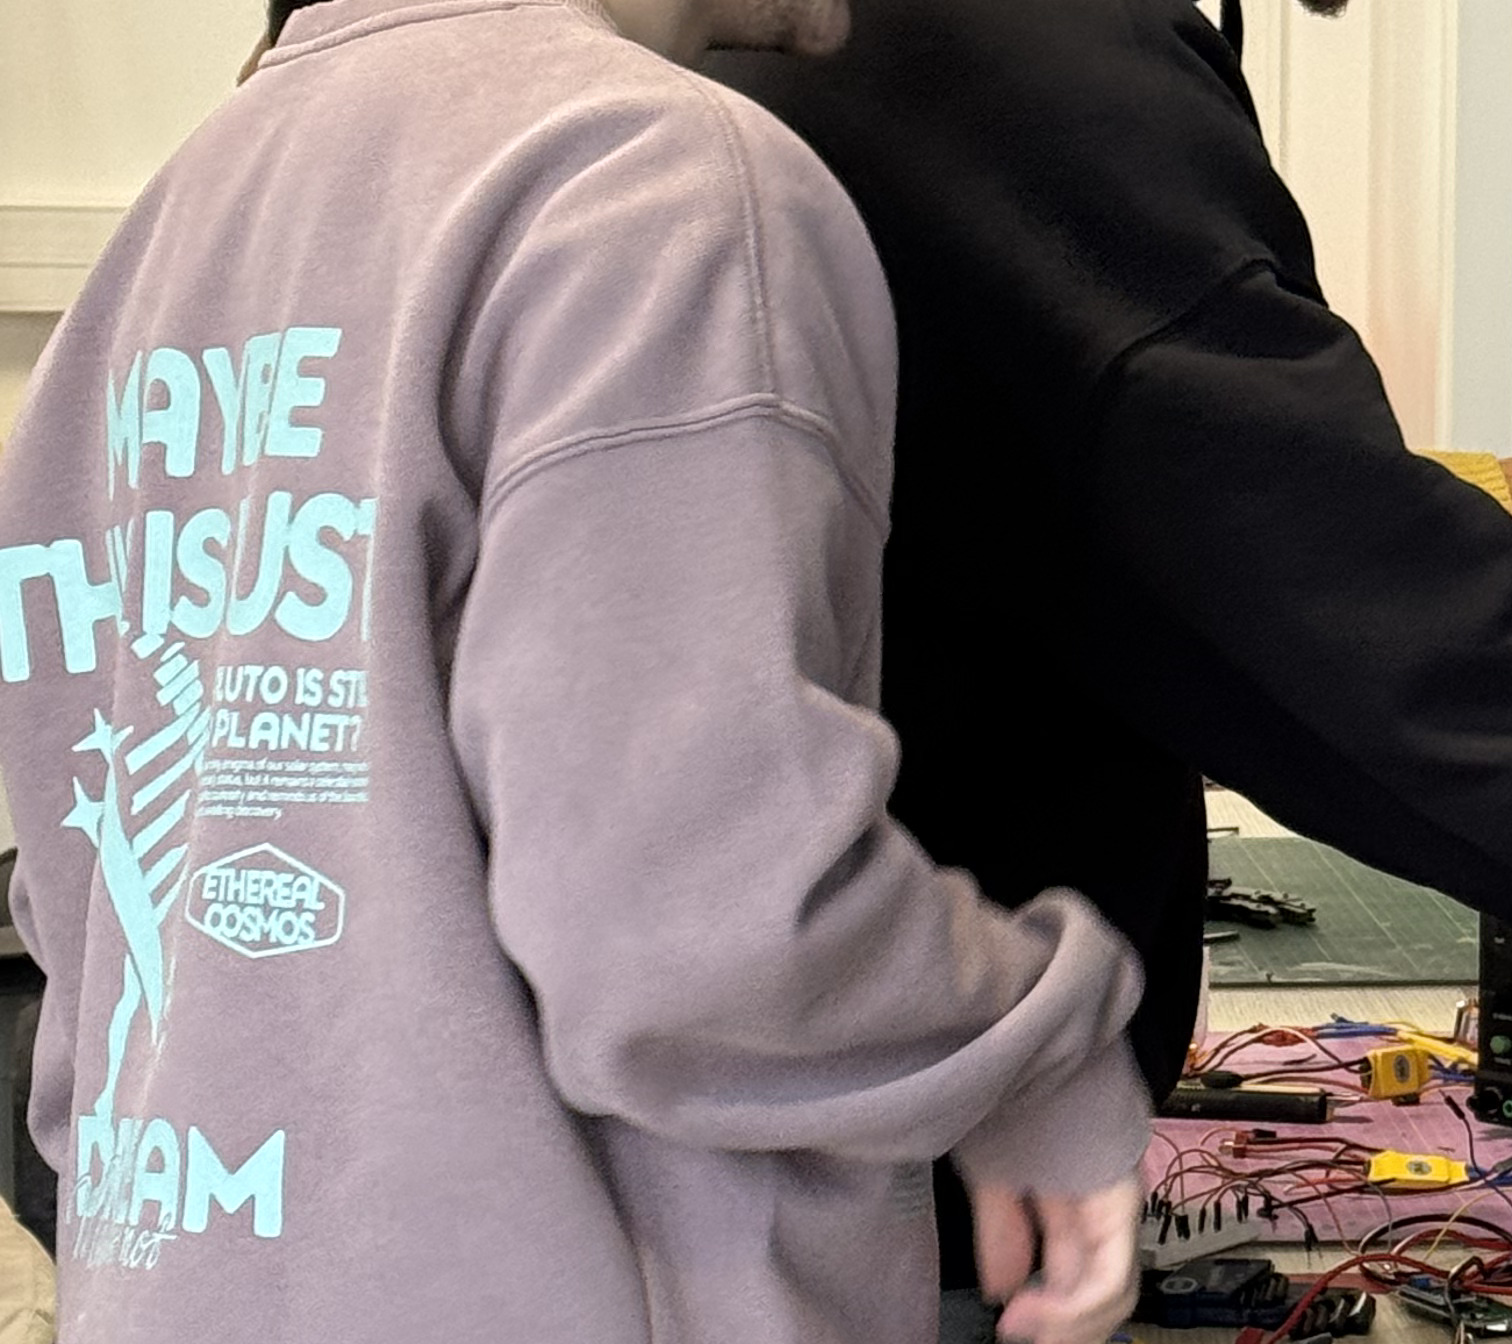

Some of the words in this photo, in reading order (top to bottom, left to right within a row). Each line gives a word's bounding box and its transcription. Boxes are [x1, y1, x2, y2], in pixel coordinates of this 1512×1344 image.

[295, 668, 324, 706] IS
[202, 867, 325, 910] ETHEREAL
[203, 903, 316, 945] COSMOS
